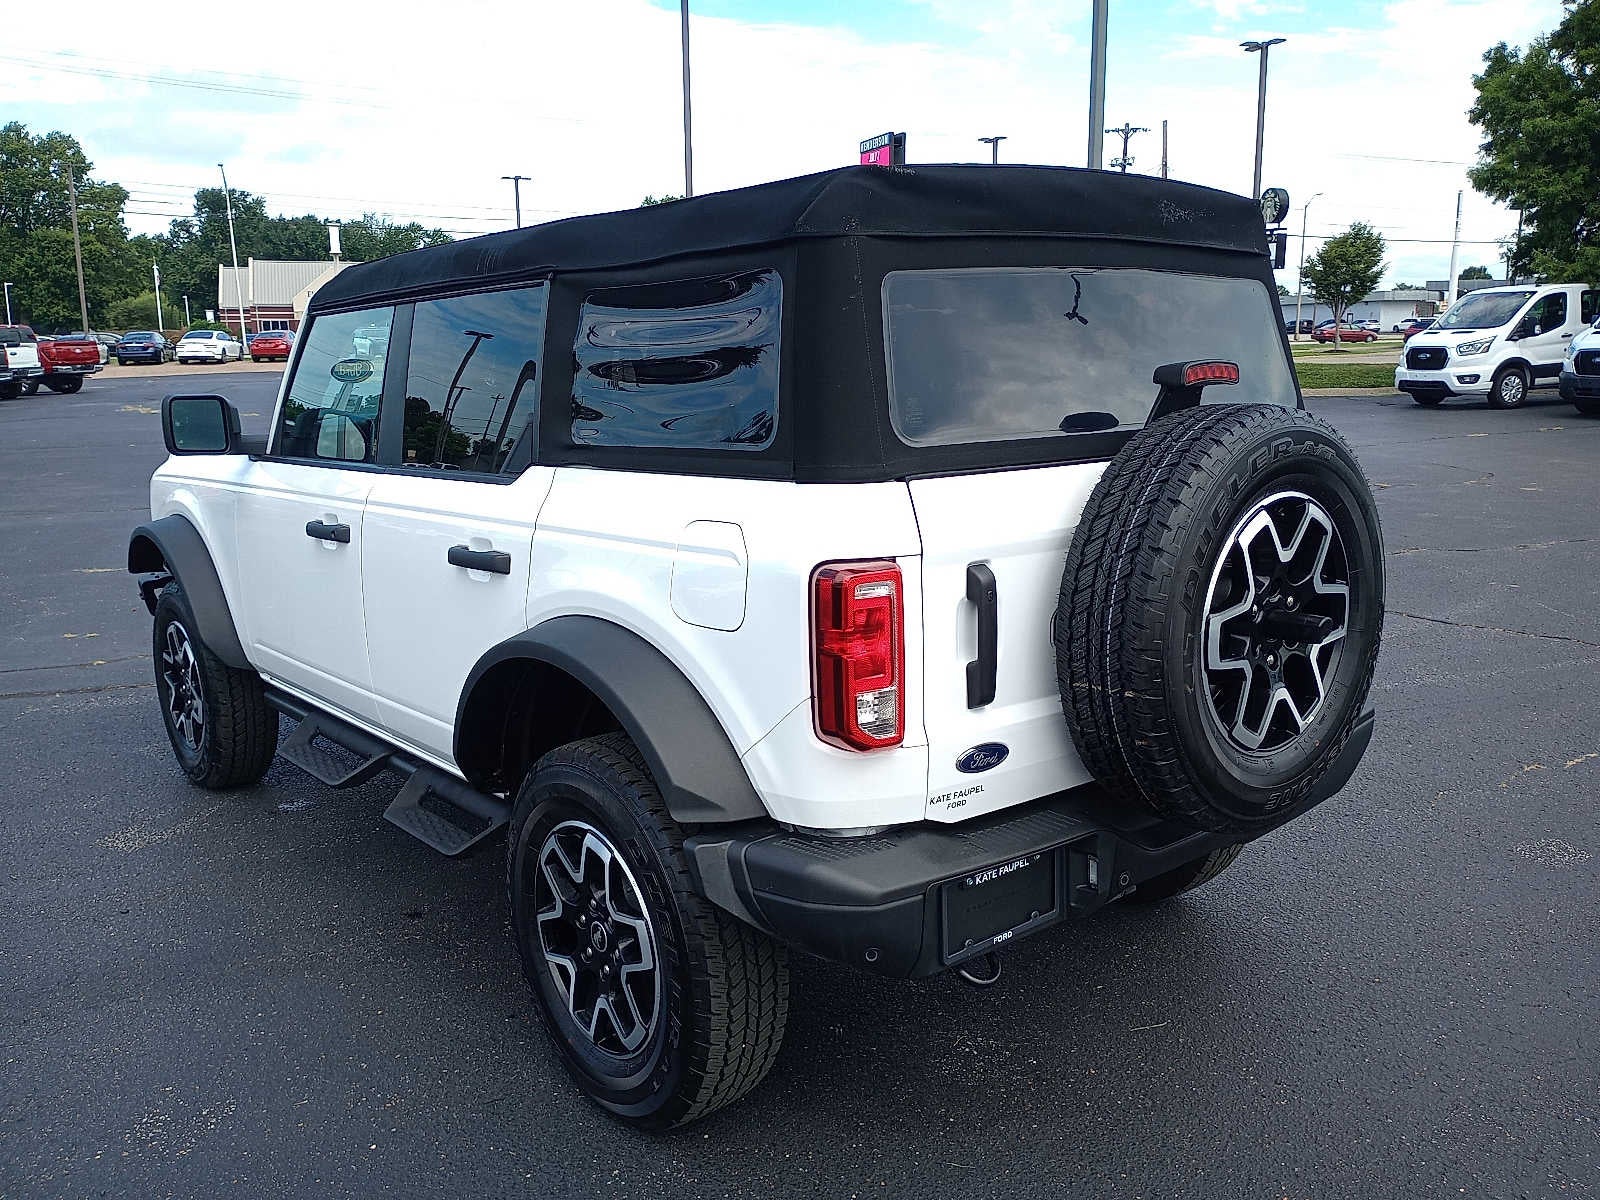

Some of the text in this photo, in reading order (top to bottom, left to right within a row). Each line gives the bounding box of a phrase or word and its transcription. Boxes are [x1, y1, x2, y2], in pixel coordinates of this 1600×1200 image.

[1177, 436, 1294, 616] DUELER
[970, 751, 999, 769] Ford
[929, 784, 985, 806] KATE FAUPEL
[946, 799, 967, 811] FORD
[975, 859, 1029, 885] KATE FAUPEL
[993, 930, 1013, 945] FORD
